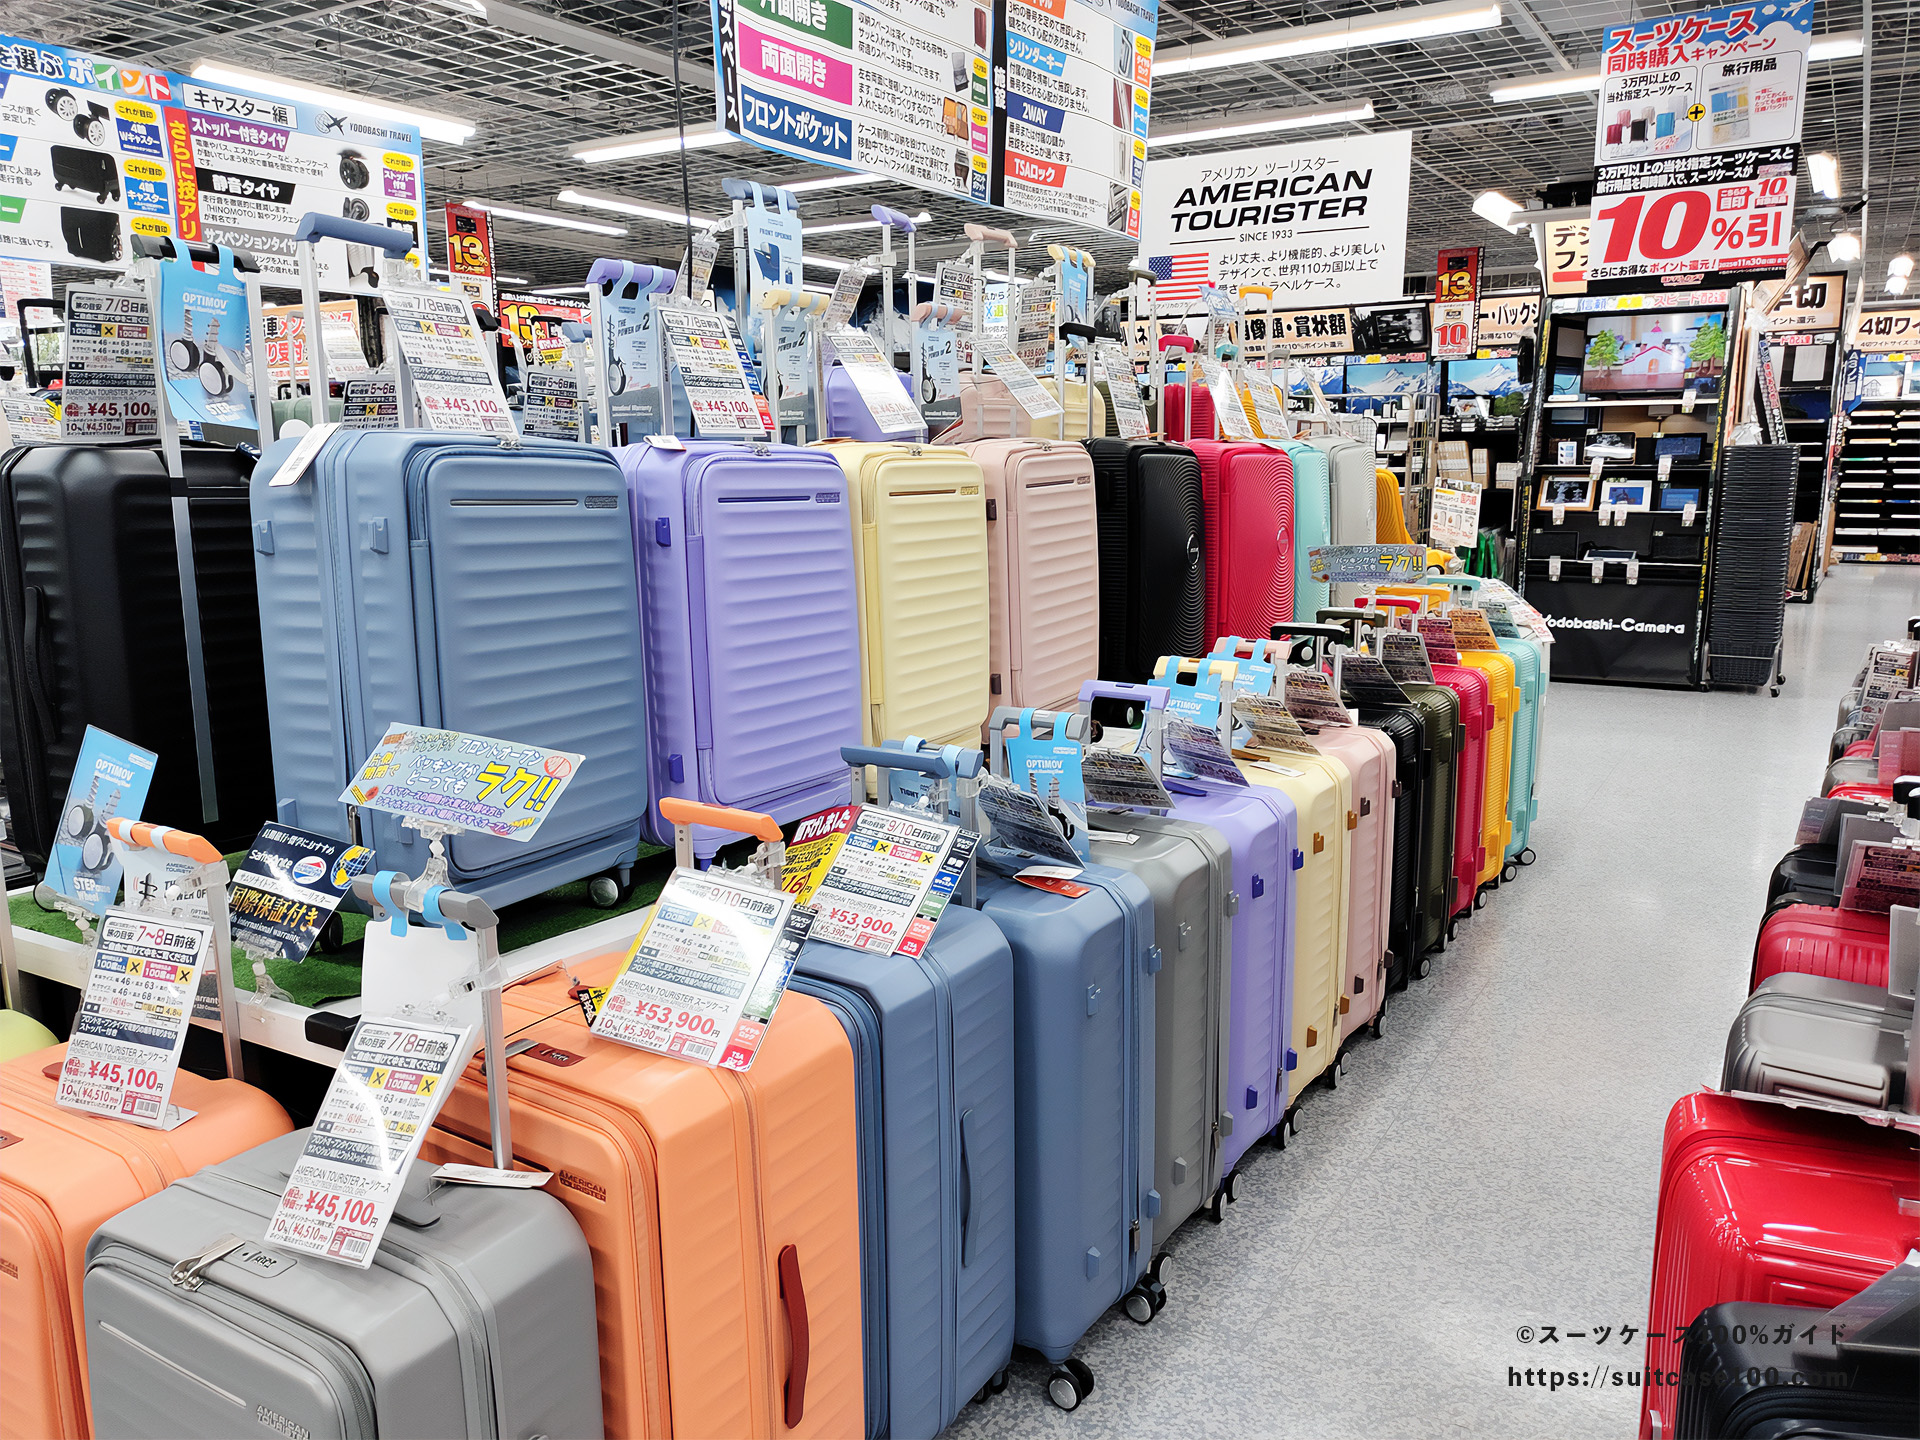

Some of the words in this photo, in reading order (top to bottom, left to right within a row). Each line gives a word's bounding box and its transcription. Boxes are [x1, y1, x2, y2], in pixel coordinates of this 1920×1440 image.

[1608, 8, 1757, 54] スーツケース
[761, 39, 827, 88] 両面開き
[1009, 38, 1064, 70] シリンダーキー
[1607, 38, 1777, 75] 同時購入キャンペーン
[1621, 71, 1681, 89] 3万円以上の
[1723, 58, 1778, 77] 旅行用品
[1607, 82, 1693, 103] 当社指定スーツケース
[3, 112, 36, 126] 安定した
[119, 105, 153, 119] これが目印
[194, 90, 289, 125] キャスター編
[1022, 102, 1048, 128] 2WAY
[192, 118, 287, 149] ストッパー付きタイヤ
[350, 122, 388, 138] YODOBASHI
[389, 130, 413, 143] TRAVEL
[744, 94, 848, 150] フロントポケット
[119, 130, 160, 146] Wキャスター
[128, 164, 163, 177] これが目印
[1014, 158, 1056, 183] TSAロック
[1201, 165, 1258, 184] アメリカン
[1265, 156, 1339, 175] ツーリスター
[1598, 146, 1794, 180] 3万円以上の当社指定スーツケースと
[168, 119, 198, 240] さらに技アリ
[212, 174, 280, 200] 静音タイヤ
[1174, 168, 1373, 209] AMERICAN
[1596, 165, 1754, 194] 旅行用品を同時購入で、スーツケースが
[1721, 187, 1747, 197] こちらが
[127, 190, 168, 203] キャスター
[1720, 196, 1745, 210] 目印
[1170, 195, 1368, 233] TOURISTER
[203, 228, 298, 254] サスペンションタイヤ
[1239, 232, 1268, 243] SINCE
[1271, 229, 1293, 240] 1933
[1218, 243, 1386, 266] より丈夫、より機能的、より美しい
[1218, 258, 1379, 280] デザインで、世界110カ国以上で
[182, 292, 228, 310] OPTIMOV
[1356, 546, 1407, 554] フロントオープン
[1340, 564, 1376, 572] とーっても
[1378, 554, 1423, 573] ラク!!
[458, 737, 545, 767] フロントオープン
[1025, 759, 1064, 770] OPTIMOV
[95, 758, 134, 781] OPTIMOV
[405, 769, 469, 795] とーっても
[408, 754, 479, 779] パッキングが
[476, 760, 562, 813] ラク!!
[230, 886, 319, 932] 国際保証付き
[106, 928, 135, 940] 旅の目安
[118, 988, 128, 997] 46
[142, 991, 152, 1000] 68
[121, 977, 131, 986] 46
[144, 981, 155, 990] 63
[618, 978, 655, 994] AMERICAN
[656, 987, 695, 1004] TOURISTER
[694, 997, 730, 1014] スーツケース
[79, 1022, 119, 1037] ストッパー付き
[71, 1038, 102, 1051] AMERICAN
[104, 1044, 138, 1057] TOURISTER
[137, 1049, 169, 1063] スーツケース
[358, 1036, 387, 1050] 旅の目安
[383, 1093, 394, 1104] 63
[294, 1166, 327, 1182] AMERICAN
[327, 1173, 359, 1187] TOURISTER
[359, 1178, 391, 1194] スーツケース
[559, 1169, 607, 1195] AMERICAN
[559, 1177, 607, 1203] TOURISTER
[256, 1404, 310, 1439] AMERICAN
